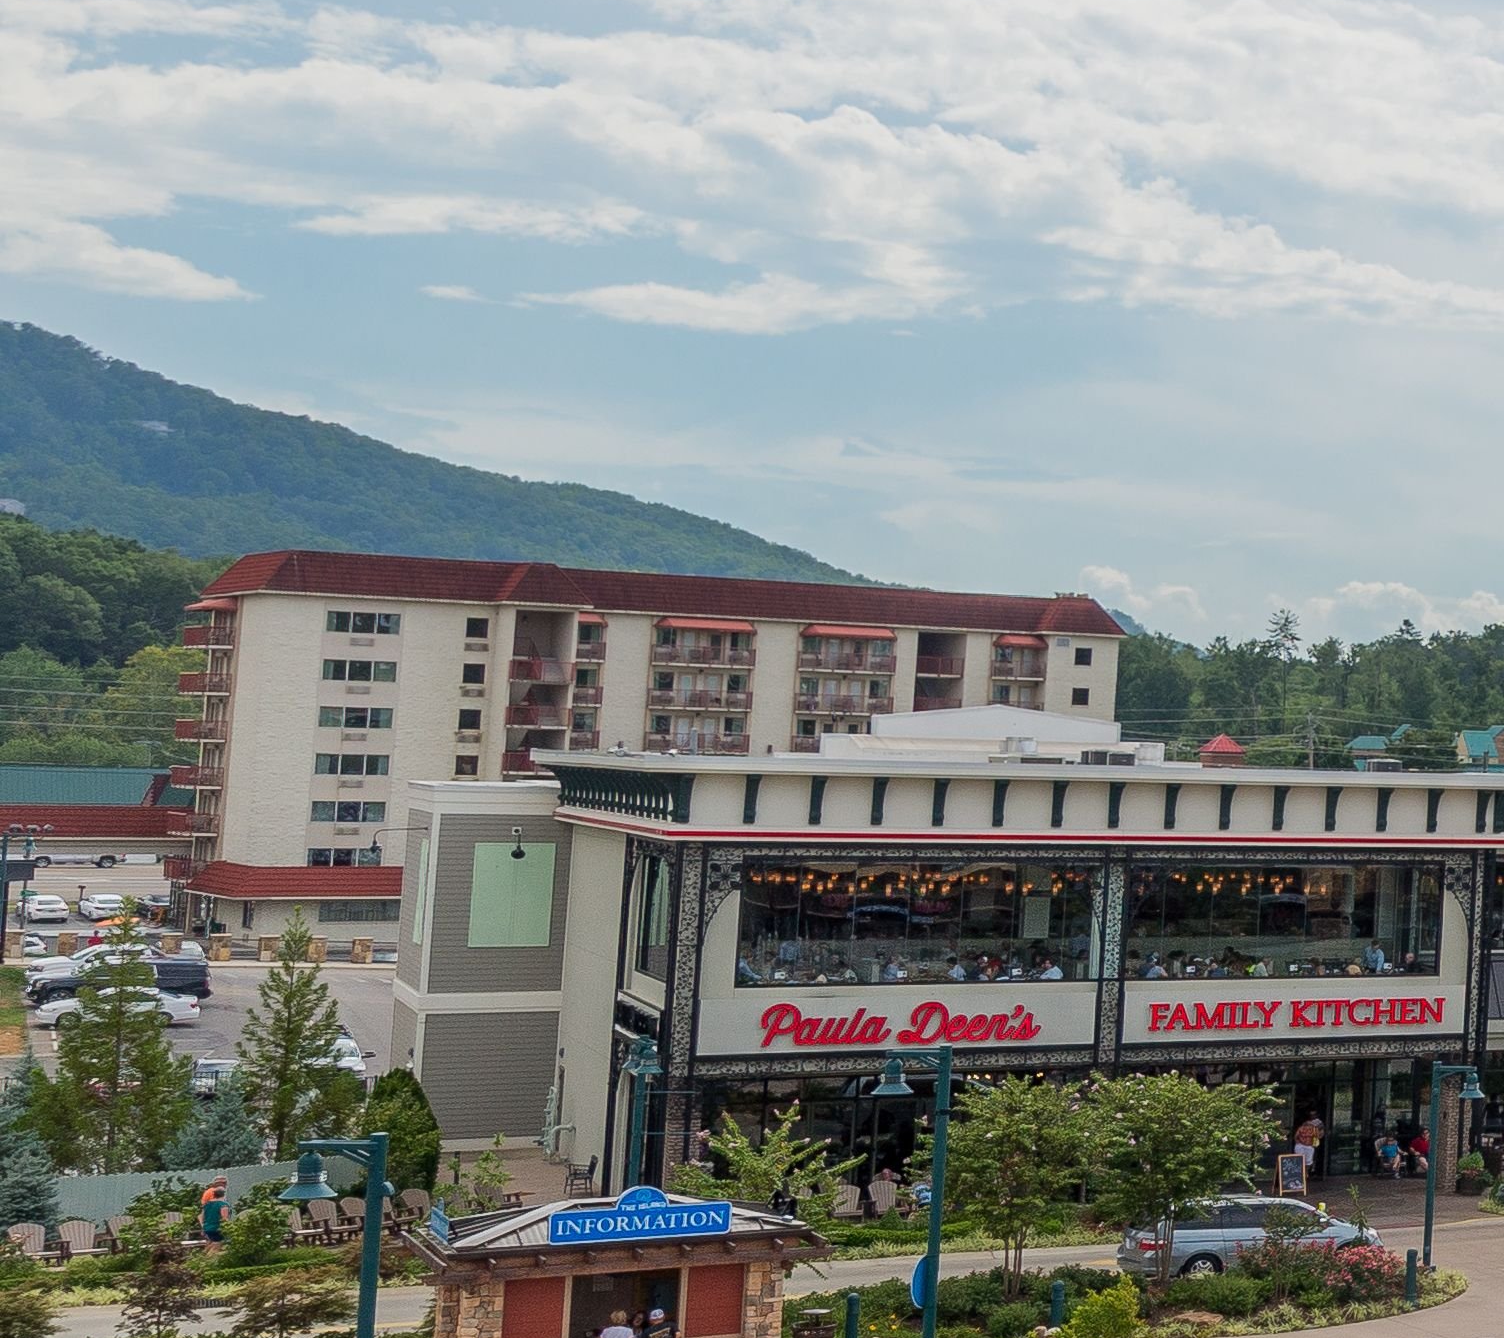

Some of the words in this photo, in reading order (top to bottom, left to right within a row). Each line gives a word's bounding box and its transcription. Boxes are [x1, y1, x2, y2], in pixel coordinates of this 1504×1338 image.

[760, 1002, 893, 1049] Paula
[896, 1000, 1043, 1046] Deen's
[1147, 1000, 1283, 1032] FAMILY
[1288, 997, 1447, 1028] KITCHEN
[556, 1209, 725, 1236] INFORMATION
